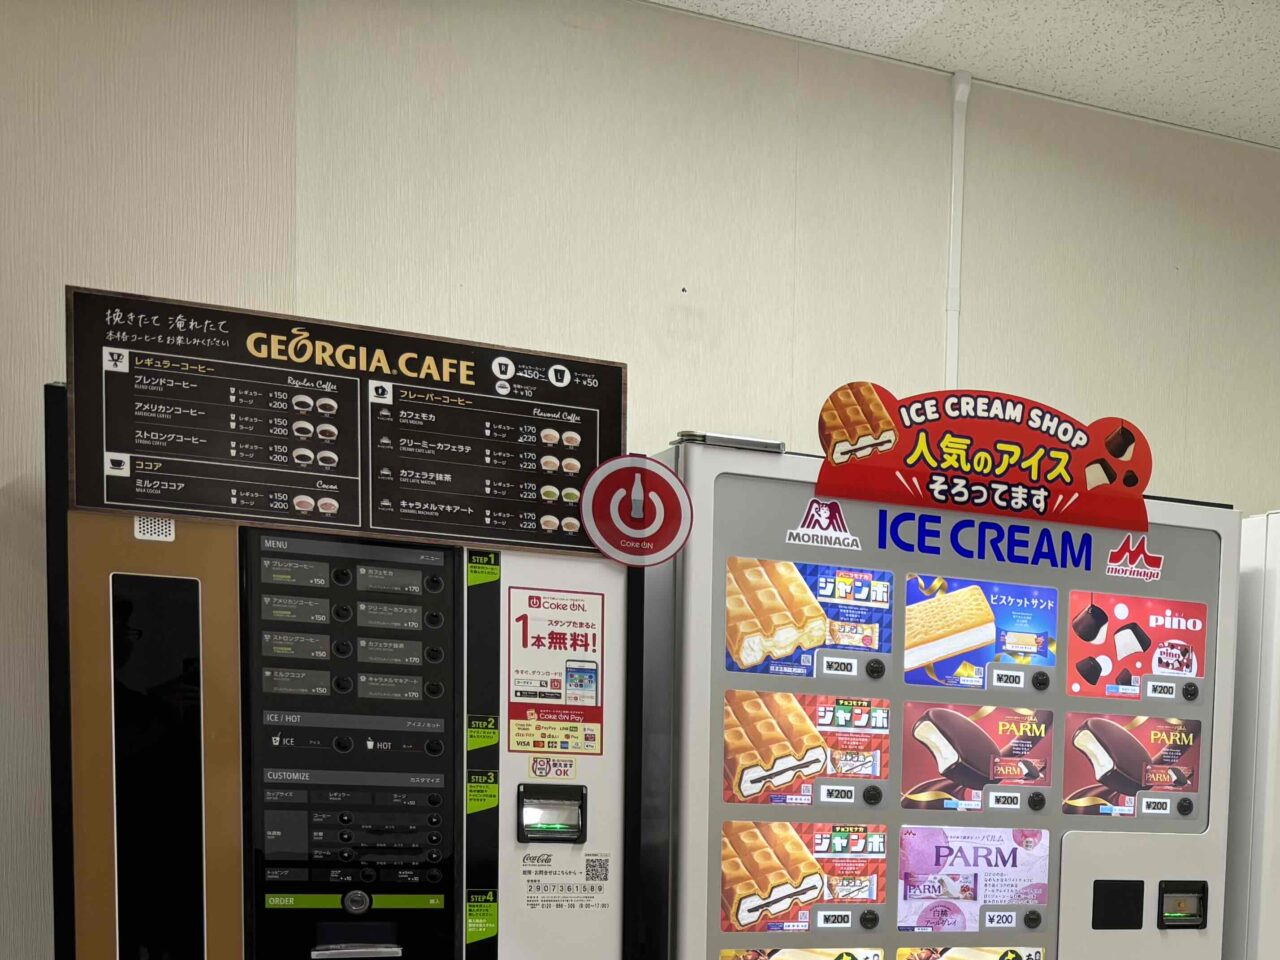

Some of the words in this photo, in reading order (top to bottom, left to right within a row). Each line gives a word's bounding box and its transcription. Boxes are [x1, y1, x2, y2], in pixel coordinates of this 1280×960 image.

[105, 309, 160, 327] 挽きたて
[246, 328, 392, 375] GEORGIA
[398, 353, 475, 385] CAFE
[135, 356, 215, 373] レギュラーコーヒー
[134, 375, 198, 389] ブレンドコーヒー
[316, 380, 338, 390] Coffee
[400, 390, 472, 406] フレーバーコーヒー
[135, 402, 206, 417] アメリカンコーヒー
[399, 410, 435, 421] カフェモカ
[898, 397, 939, 428] ICE
[944, 395, 1023, 422] CREAM
[1028, 407, 1089, 448] SHOP
[135, 431, 207, 444] ストロングコーヒー
[399, 438, 471, 453] クリーミーカフェラテ
[904, 432, 1073, 482] 人気のアイス
[136, 461, 162, 471] ココア
[399, 469, 451, 482] カフェラテ抹茶
[136, 479, 185, 492] ミルクココア
[928, 475, 1049, 512] そろってます
[400, 500, 474, 514] キャラメルマキアート
[264, 540, 288, 549] MENU
[786, 531, 859, 549] MORINAGA
[877, 509, 941, 554] ICE
[949, 519, 1092, 571] CREAM
[472, 555, 488, 564] STEP
[488, 553, 495, 564] 1
[1105, 564, 1161, 580] morinaga
[817, 576, 890, 603] ジャンボ
[542, 600, 568, 610] Coke
[990, 594, 1055, 611] ビスケットサンド
[547, 619, 597, 630] スタンプたまると
[1149, 608, 1203, 631] pino
[826, 661, 853, 672] ¥200
[996, 673, 1021, 685] ¥200
[1151, 684, 1174, 696] ¥200
[471, 721, 488, 729] STEP
[488, 718, 495, 728] 2
[540, 712, 557, 720] Coke
[570, 714, 584, 722] Pay
[816, 706, 889, 729] ジャンボ
[998, 720, 1046, 738] PARM
[1150, 730, 1193, 746] PARM
[267, 772, 310, 781] CUSTOMIZE
[471, 774, 488, 782] STEP
[487, 772, 494, 782] 3
[555, 768, 570, 777] OK
[827, 788, 853, 799] ¥200
[994, 795, 1019, 806] ¥200
[1145, 800, 1168, 811] ¥200
[813, 832, 885, 855] ジャンボ
[933, 844, 1018, 869] PARM
[908, 885, 941, 895] PARM
[823, 913, 849, 924] ¥200
[987, 914, 1014, 925] ¥200
